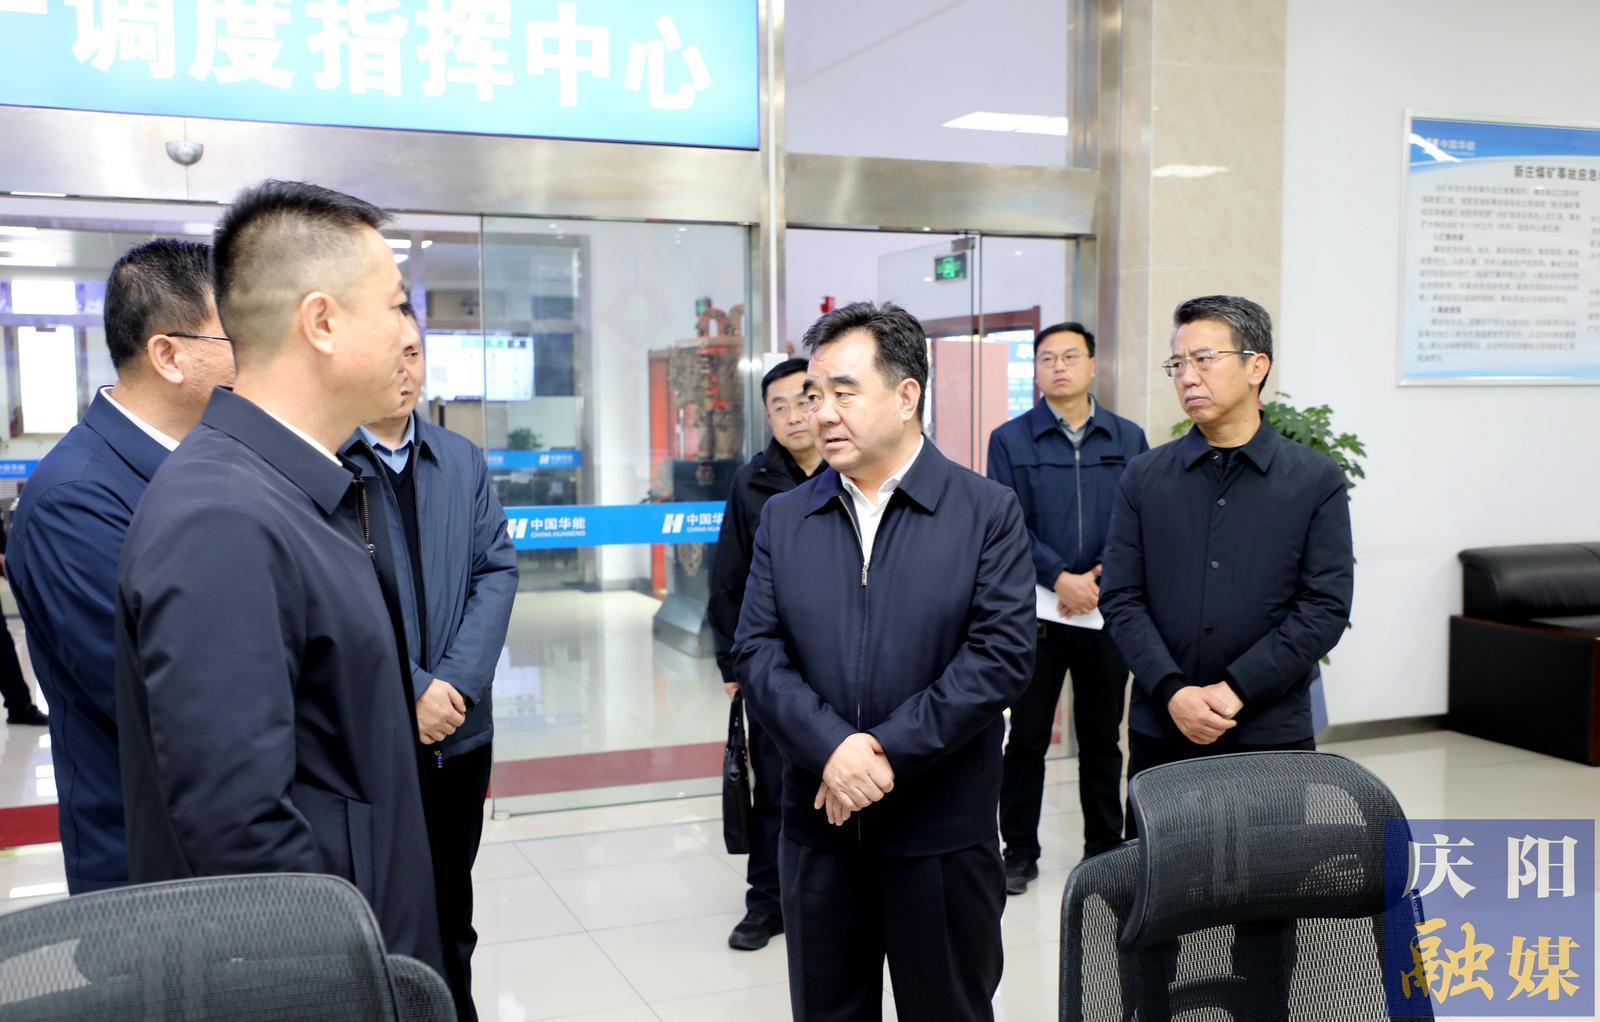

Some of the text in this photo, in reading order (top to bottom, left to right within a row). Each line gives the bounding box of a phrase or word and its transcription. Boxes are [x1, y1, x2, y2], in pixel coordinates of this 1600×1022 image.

[1514, 165, 1600, 182] 新庄煤矿事故应急
[530, 516, 586, 531] 中国华能
